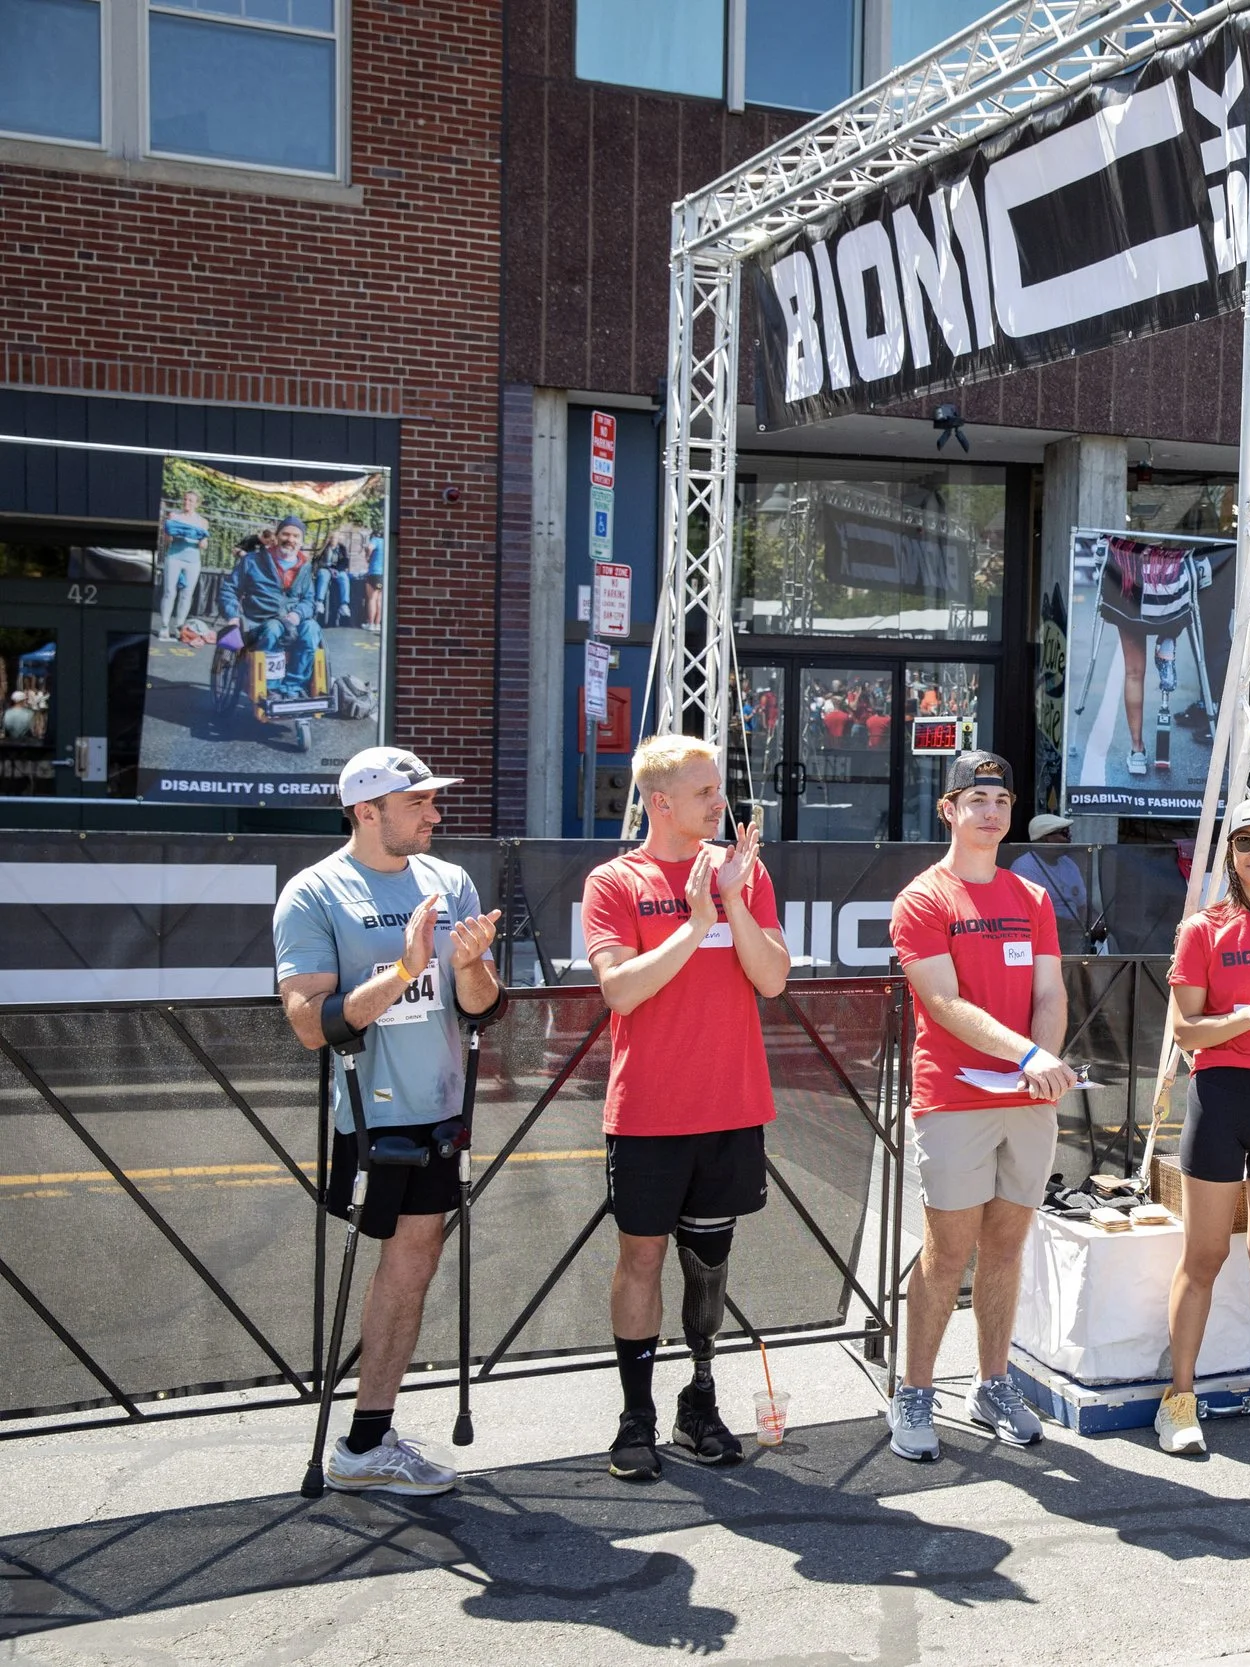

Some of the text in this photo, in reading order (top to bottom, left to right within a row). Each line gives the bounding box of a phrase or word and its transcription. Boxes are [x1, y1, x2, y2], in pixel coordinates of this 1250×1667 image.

[771, 45, 1248, 404] BIONIC 5K
[600, 426, 608, 438] NO
[602, 566, 614, 576] TOW
[67, 583, 99, 605] 42
[603, 588, 625, 599] PARKING
[160, 779, 254, 795] DISABILITY
[258, 783, 275, 794] IS
[1071, 794, 1228, 809] DISABILITY IS FASHIONAE.
[949, 917, 1032, 937] BIONIC
[1008, 948, 1025, 960] Ryan
[391, 974, 435, 1006] 84
